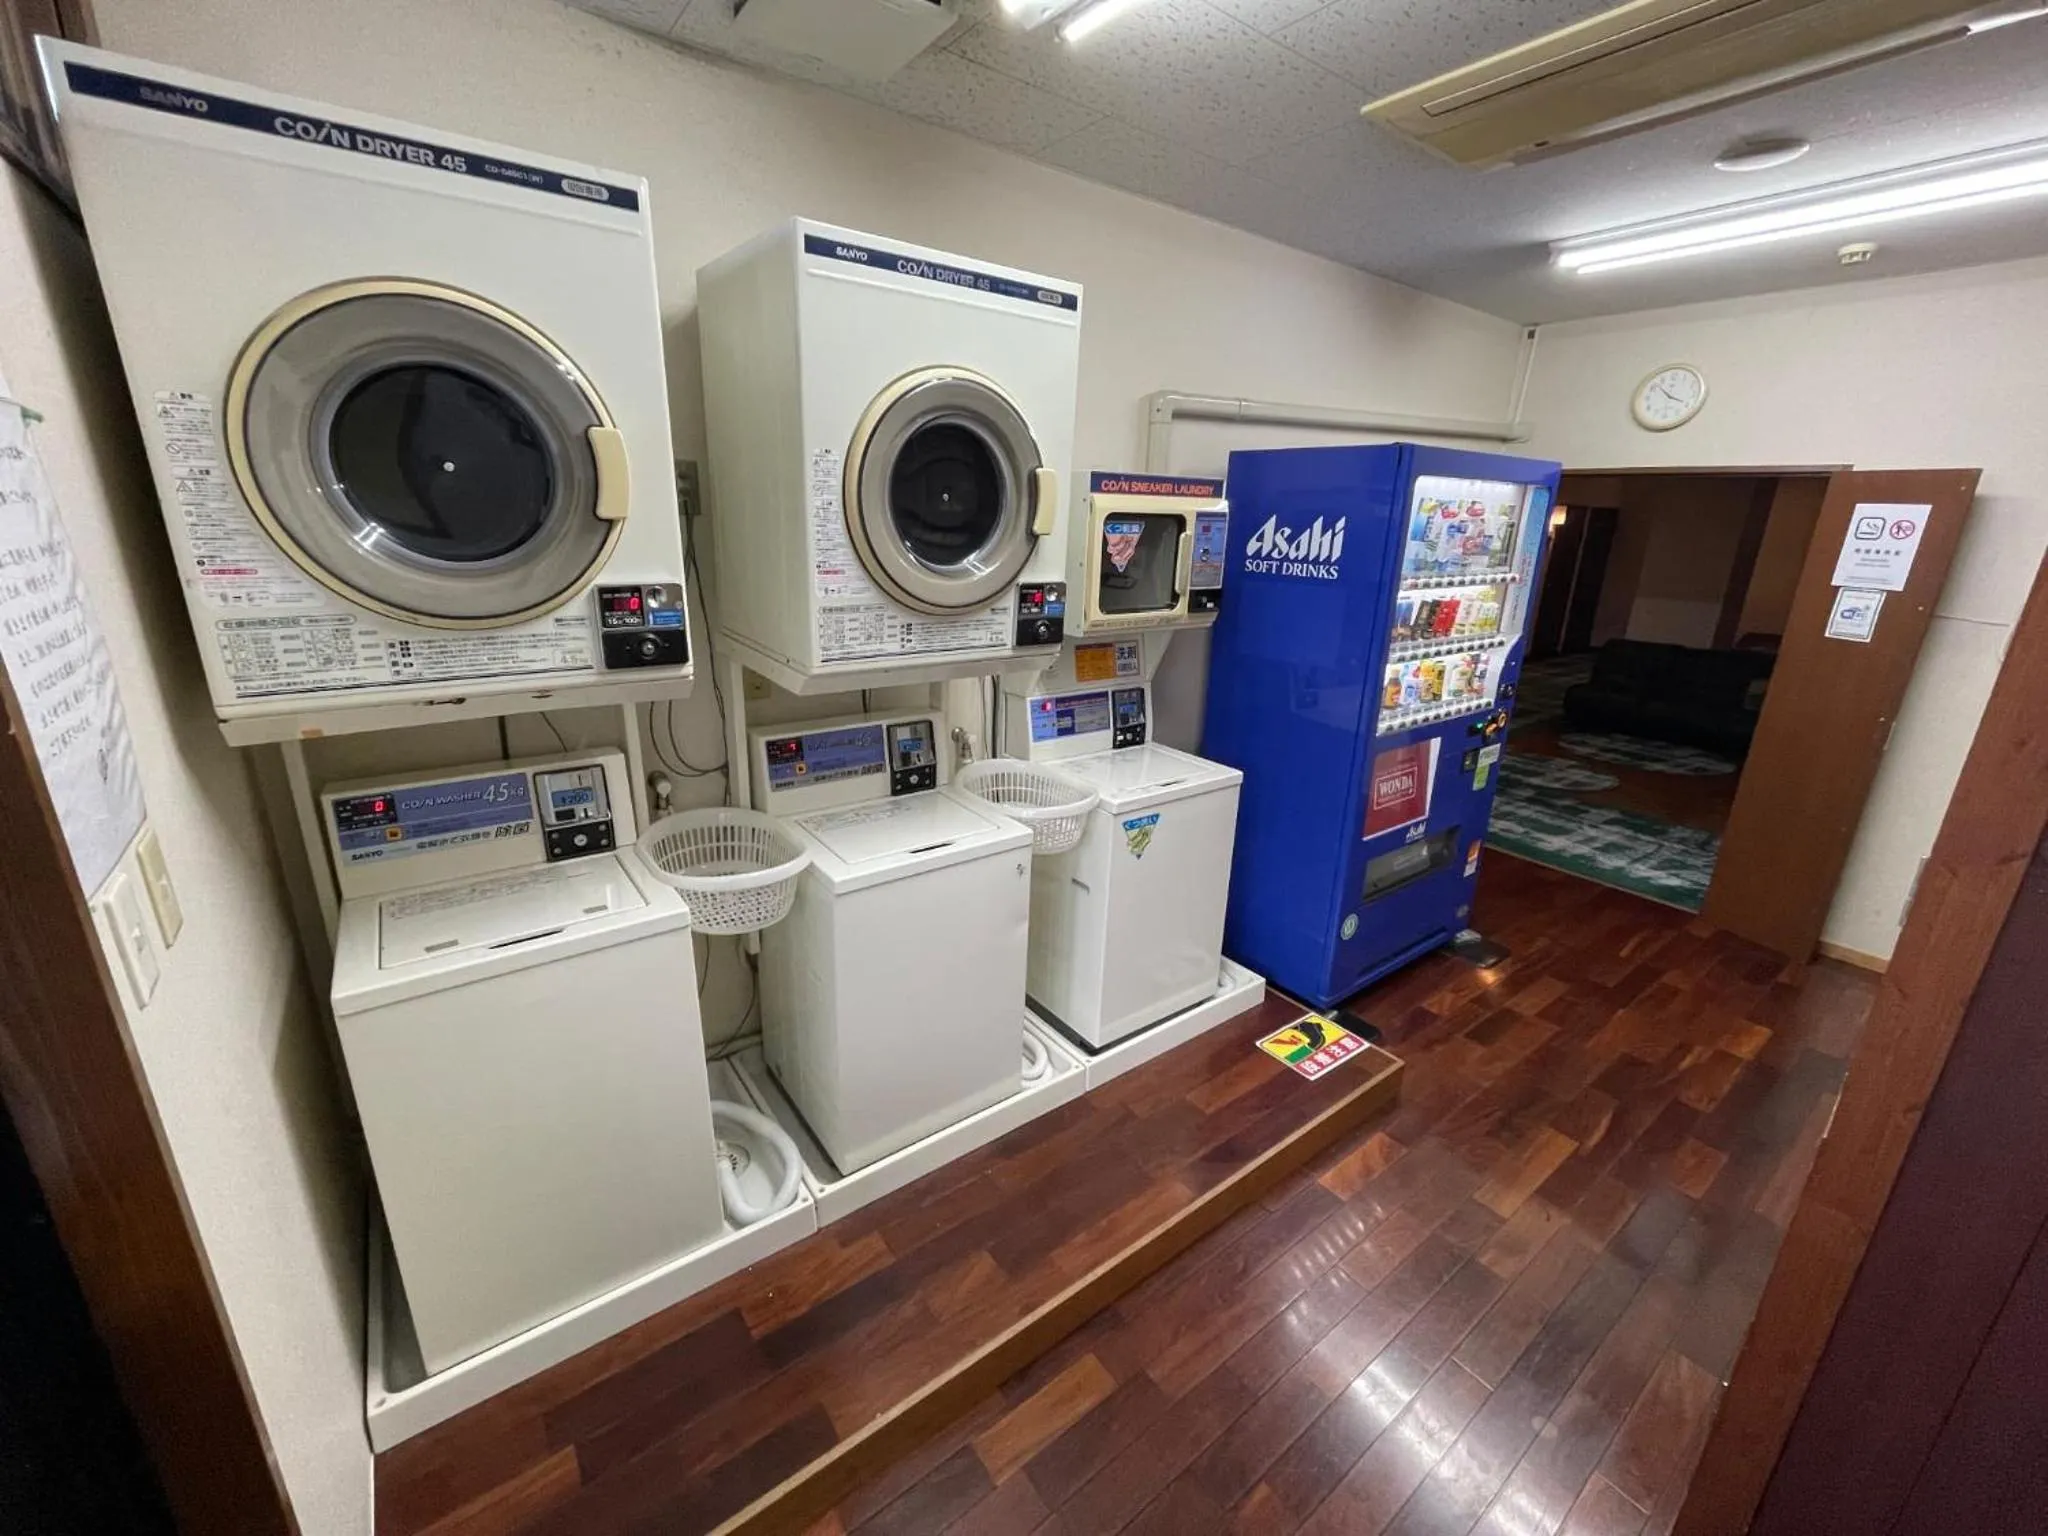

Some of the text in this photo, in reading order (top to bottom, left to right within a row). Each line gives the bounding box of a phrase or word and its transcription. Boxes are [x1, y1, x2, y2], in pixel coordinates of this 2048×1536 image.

[139, 86, 209, 112] SANYO
[356, 134, 436, 168] DRYER
[440, 154, 468, 174] 45
[835, 245, 868, 262] SANYO
[936, 271, 975, 289] DRYER
[977, 277, 991, 291] 45
[1131, 481, 1173, 493] SNEAKER
[1174, 485, 1214, 495] LAUNDRY
[1246, 513, 1346, 563] Asahi
[1245, 558, 1339, 580] SOFT DRINKS
[436, 791, 481, 805] WASHER
[351, 849, 384, 862] SANYO
